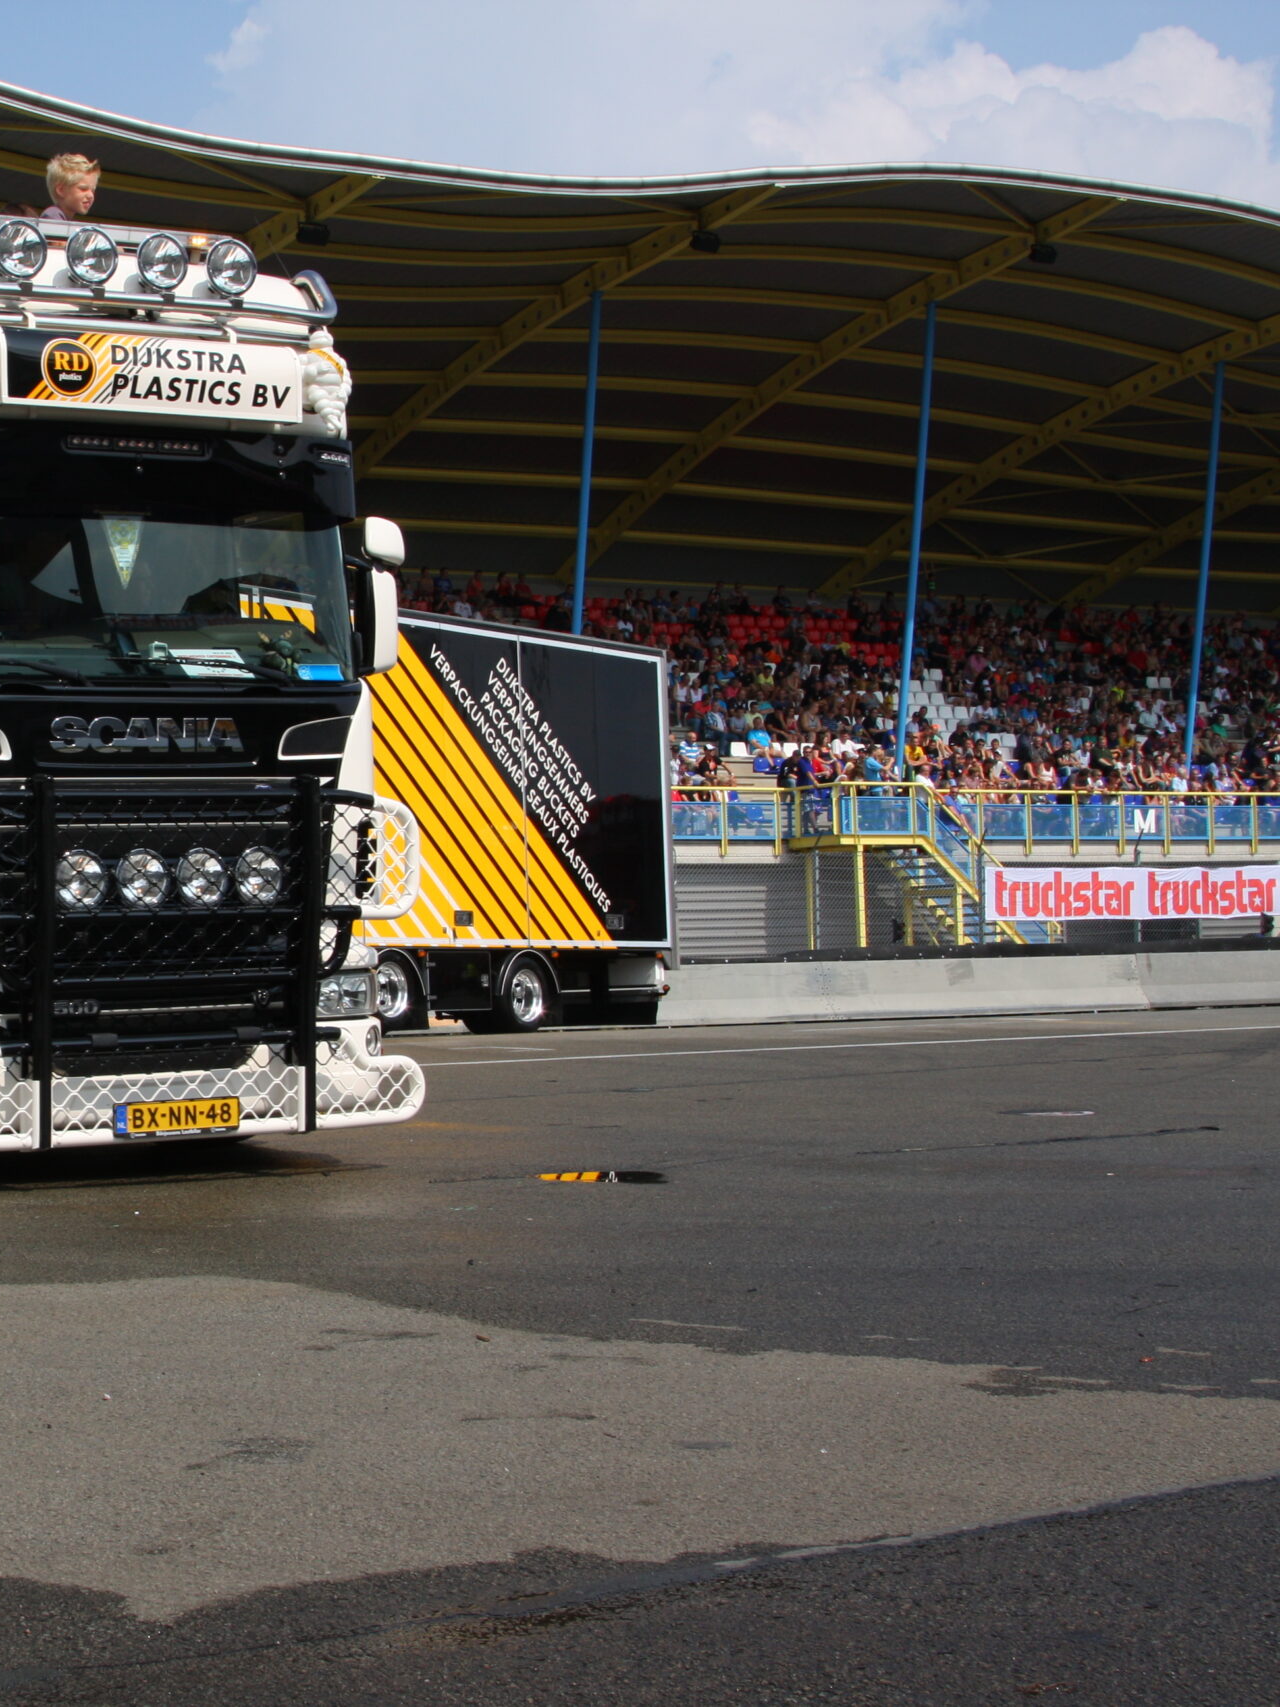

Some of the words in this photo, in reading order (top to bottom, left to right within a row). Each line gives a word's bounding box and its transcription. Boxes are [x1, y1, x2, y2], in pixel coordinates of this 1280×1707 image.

[53, 350, 89, 372] RD
[59, 372, 82, 382] plastics
[110, 344, 246, 375] DIJKSTRA
[110, 373, 241, 406] PLASTICS
[252, 383, 291, 408] BV
[49, 716, 245, 753] SCANIA
[488, 670, 589, 825] VERPAKKINGSEMMERS
[496, 657, 540, 726] DIJKSTRA
[539, 723, 582, 783] PLASTICS
[580, 780, 596, 803] BV
[430, 643, 528, 793] VERPACKUNGSEIMER
[526, 789, 559, 839] SEAUX
[557, 833, 612, 913] PLASTIQUES
[480, 692, 539, 778] PACKAGING
[537, 778, 580, 839] BUCKETS
[1134, 809, 1156, 833] M
[995, 870, 1134, 917] truckstar
[1147, 870, 1277, 917] truckstar
[132, 1103, 232, 1129] BX-NN-48
